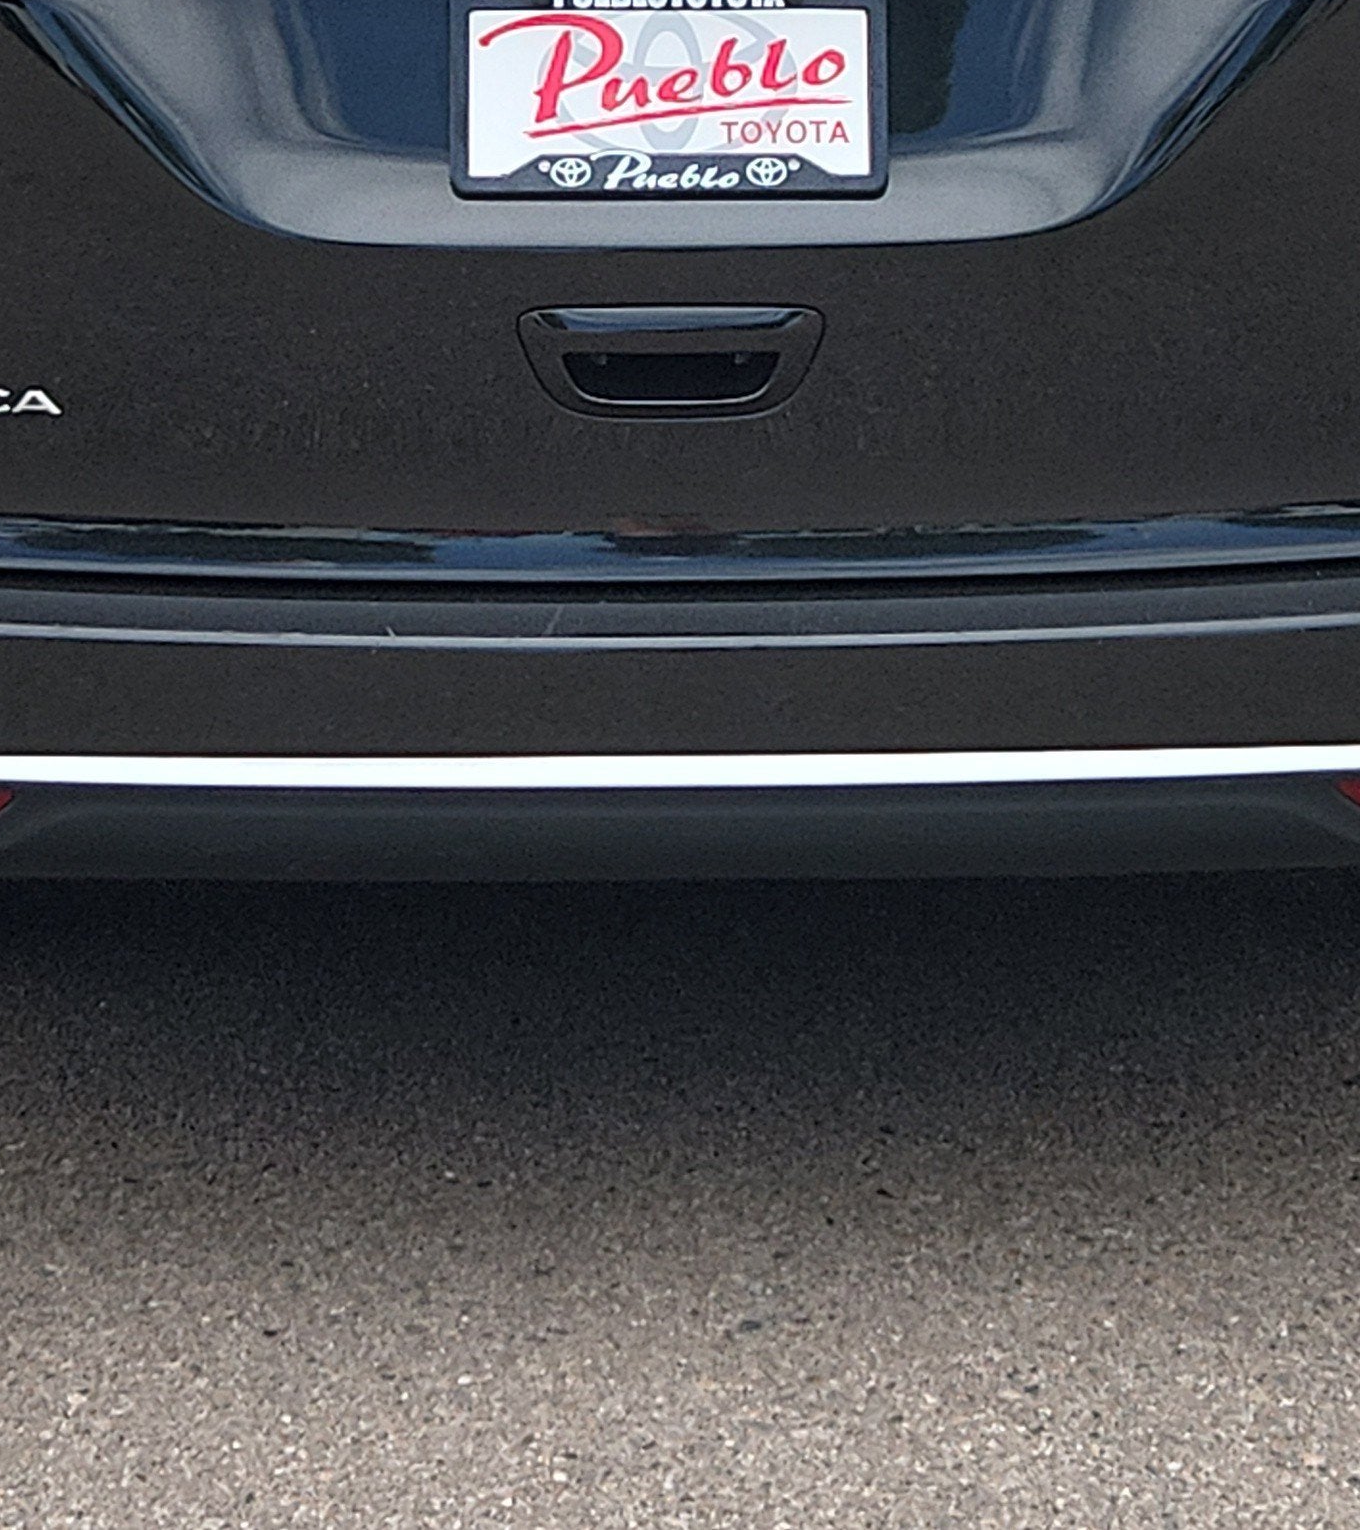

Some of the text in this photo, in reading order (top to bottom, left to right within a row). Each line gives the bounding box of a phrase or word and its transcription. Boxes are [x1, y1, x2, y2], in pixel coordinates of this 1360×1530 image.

[478, 13, 846, 123] Pueblo
[721, 120, 851, 145] TOYOTA
[589, 149, 740, 190] Pueblo
